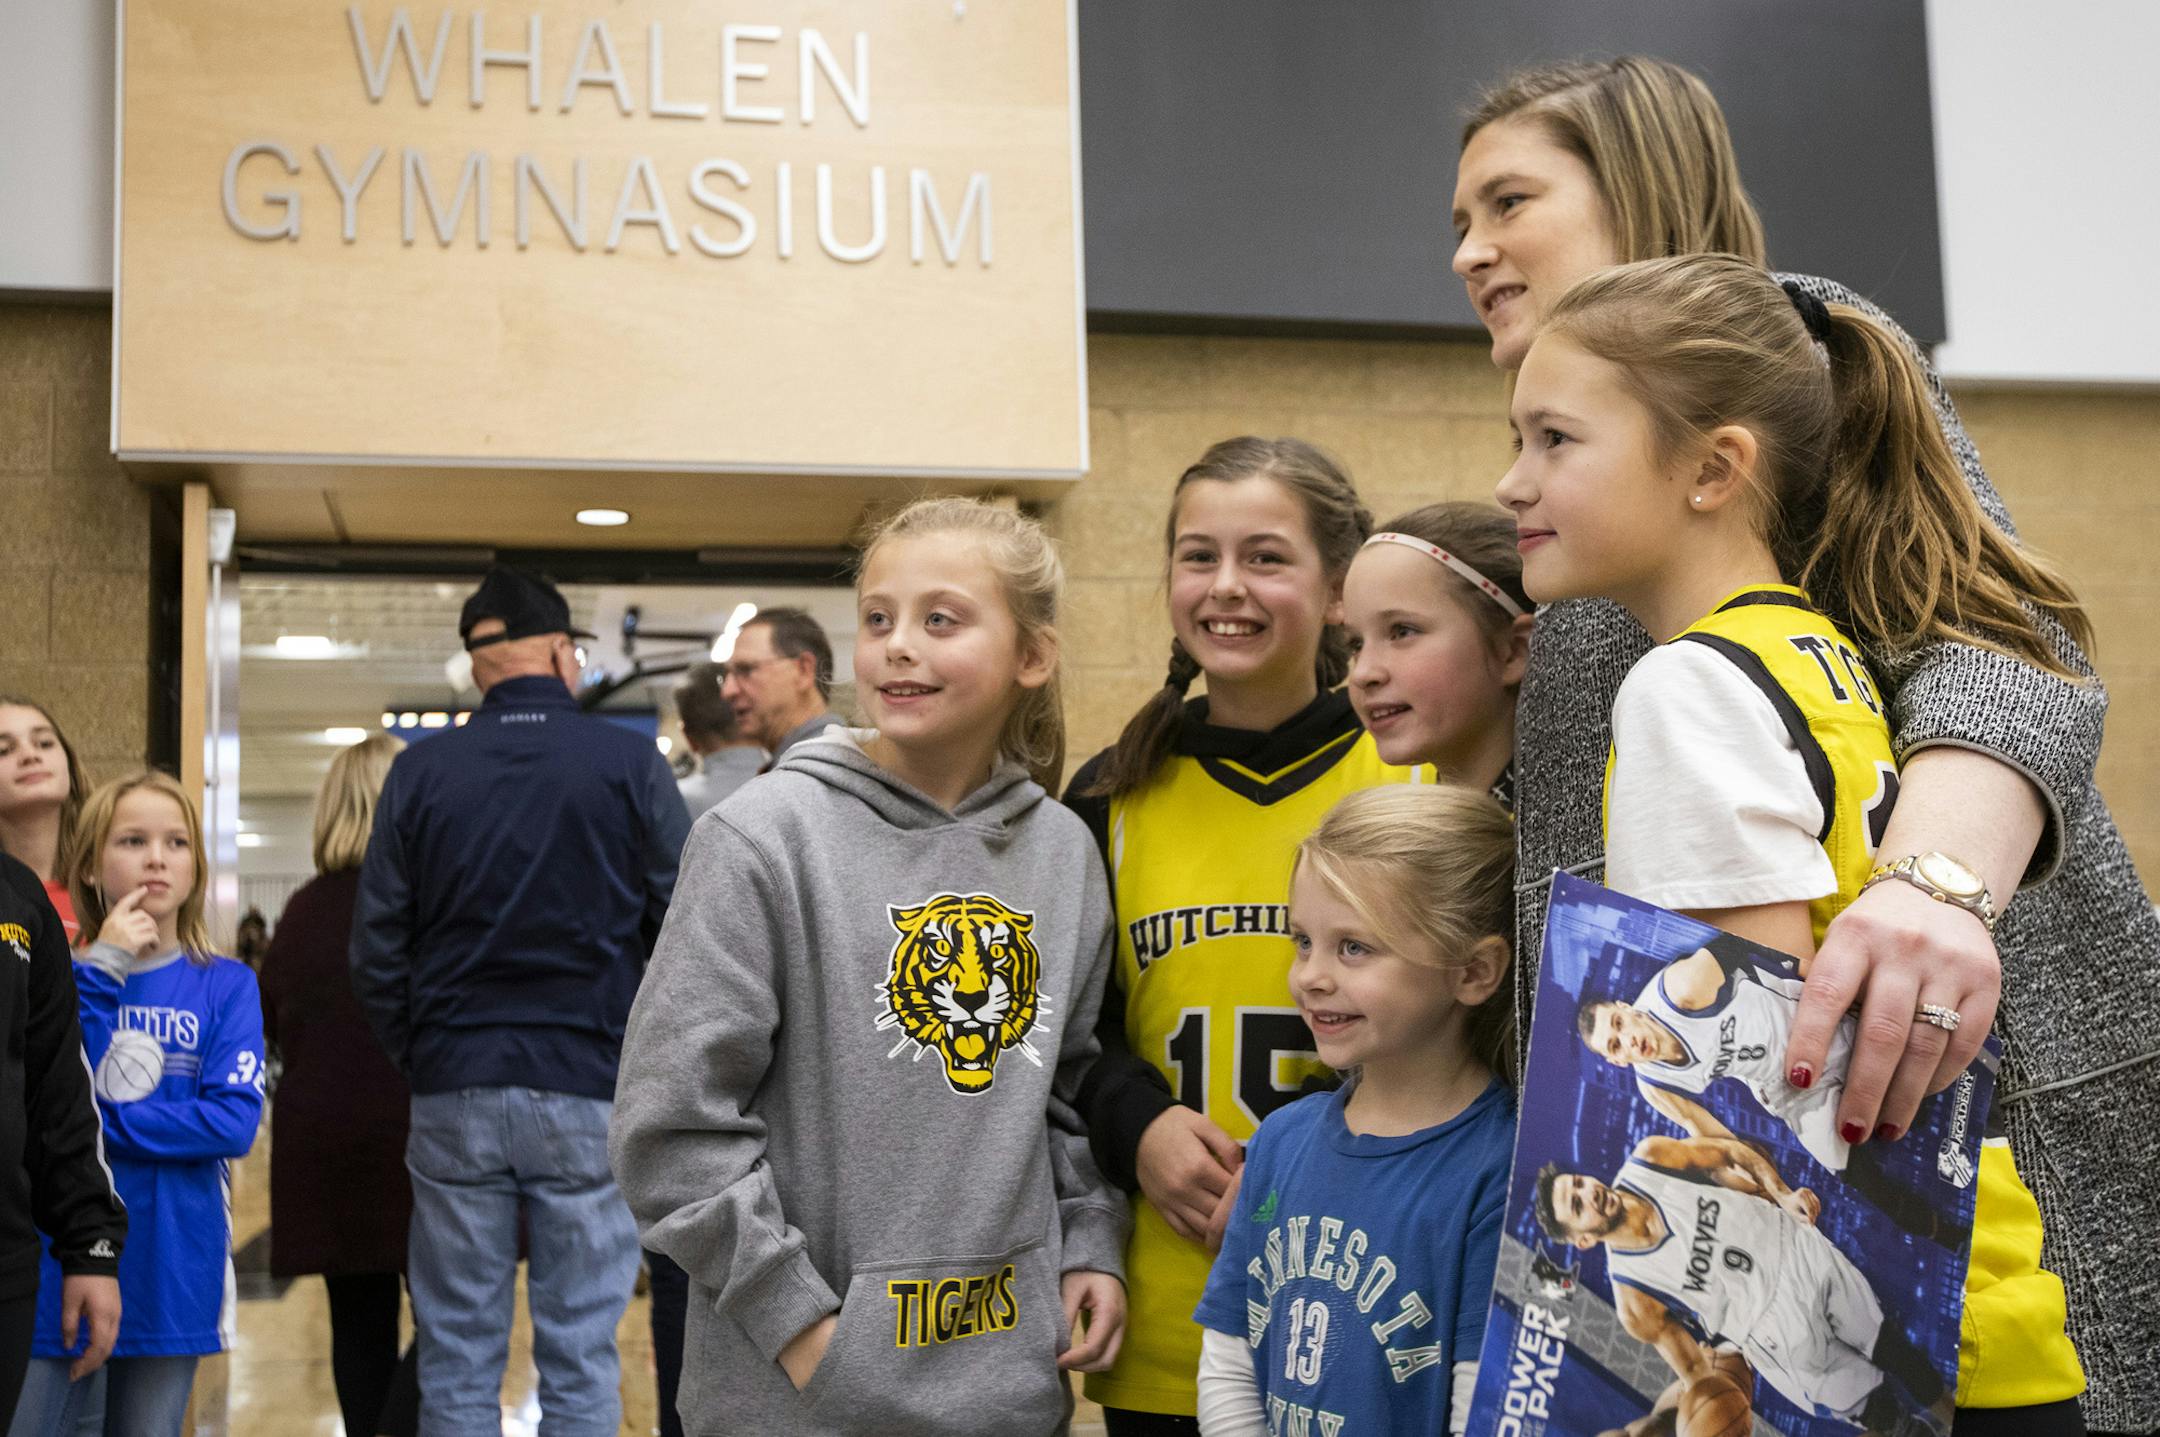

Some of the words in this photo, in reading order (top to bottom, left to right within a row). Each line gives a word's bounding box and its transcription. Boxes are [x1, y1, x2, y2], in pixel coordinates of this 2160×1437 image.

[346, 5, 871, 128] WHALEN
[221, 140, 993, 269] GYMNASIUM
[1128, 904, 1292, 977] HUTCHI
[118, 1004, 200, 1050] NTS
[1736, 1043, 1768, 1062] 8
[1164, 1006, 1320, 1162] 15
[1955, 1069, 1975, 1145] ACADEMY
[1682, 1196, 1720, 1296] WOLVES
[1722, 1245, 1755, 1275] 9
[887, 1264, 1019, 1348] TIGERS
[1247, 1216, 1442, 1384] MINNESOTA
[1284, 1297, 1330, 1386] 13
[1527, 1309, 1571, 1420] PACK
